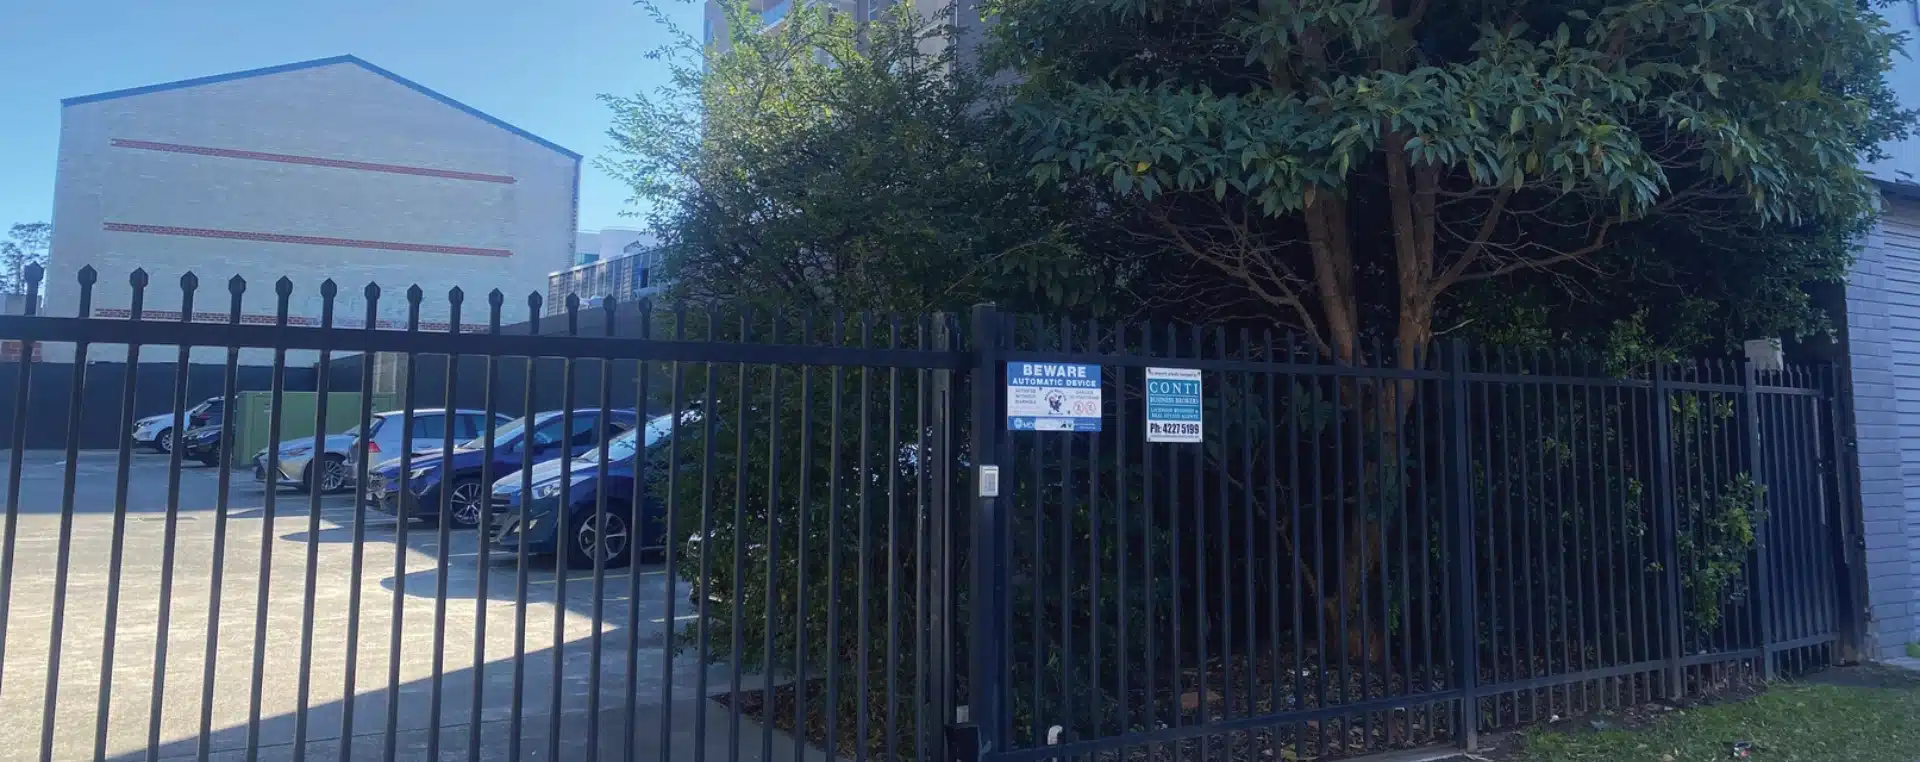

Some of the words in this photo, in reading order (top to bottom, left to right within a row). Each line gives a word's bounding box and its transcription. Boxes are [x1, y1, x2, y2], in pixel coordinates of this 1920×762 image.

[1023, 364, 1087, 378] BEWARE
[1012, 377, 1063, 387] AUTOMATIC
[1066, 379, 1097, 388] DEVICE
[1149, 381, 1198, 395] CONTI
[1149, 396, 1174, 404] BUSINESS
[1175, 397, 1199, 405] BROKERS
[1150, 423, 1162, 434] Ph:
[1162, 423, 1180, 434] 4227
[1181, 423, 1200, 435] 5199
